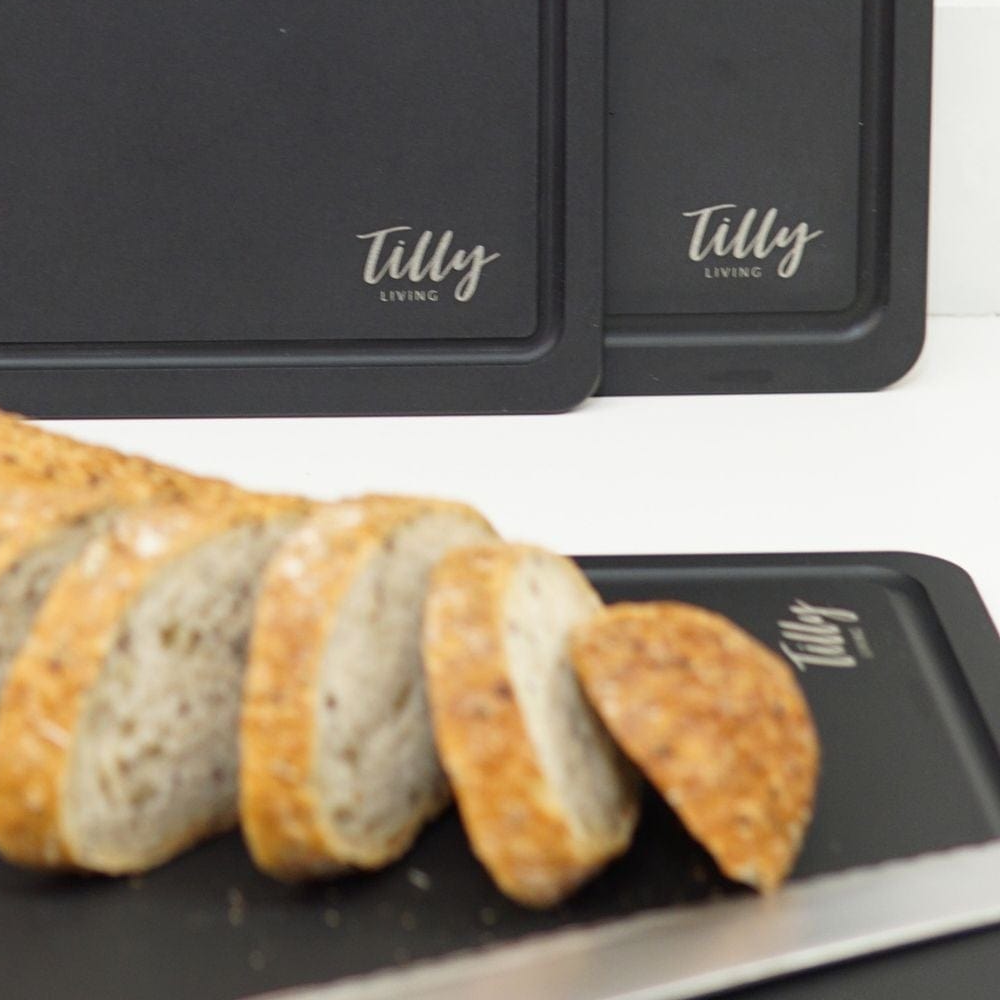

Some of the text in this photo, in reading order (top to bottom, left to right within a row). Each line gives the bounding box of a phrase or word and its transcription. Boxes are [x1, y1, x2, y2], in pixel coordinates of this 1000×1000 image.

[355, 225, 501, 302] Tilly
[682, 203, 824, 279] Tilly
[704, 266, 763, 279] LIVING
[379, 289, 440, 302] LIVING
[776, 598, 860, 673] Tilly
